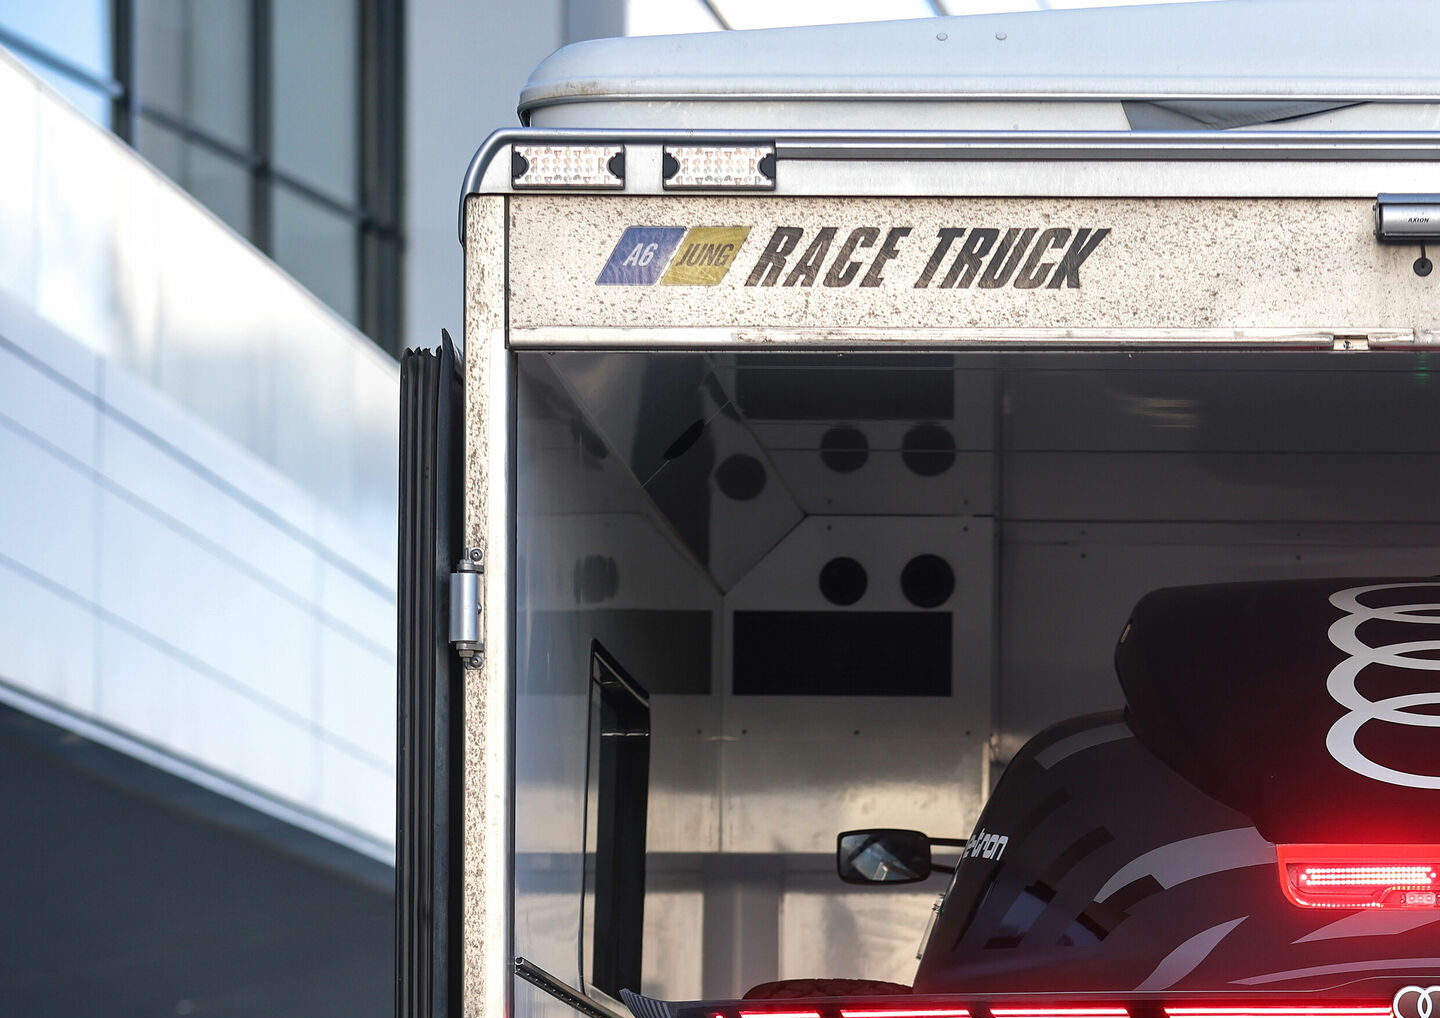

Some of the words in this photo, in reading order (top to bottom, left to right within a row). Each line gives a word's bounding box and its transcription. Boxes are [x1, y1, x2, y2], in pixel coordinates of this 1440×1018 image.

[623, 243, 659, 267] A6
[676, 243, 735, 267] JUNG
[745, 228, 913, 288] RACE
[914, 228, 1112, 289] TRUCK
